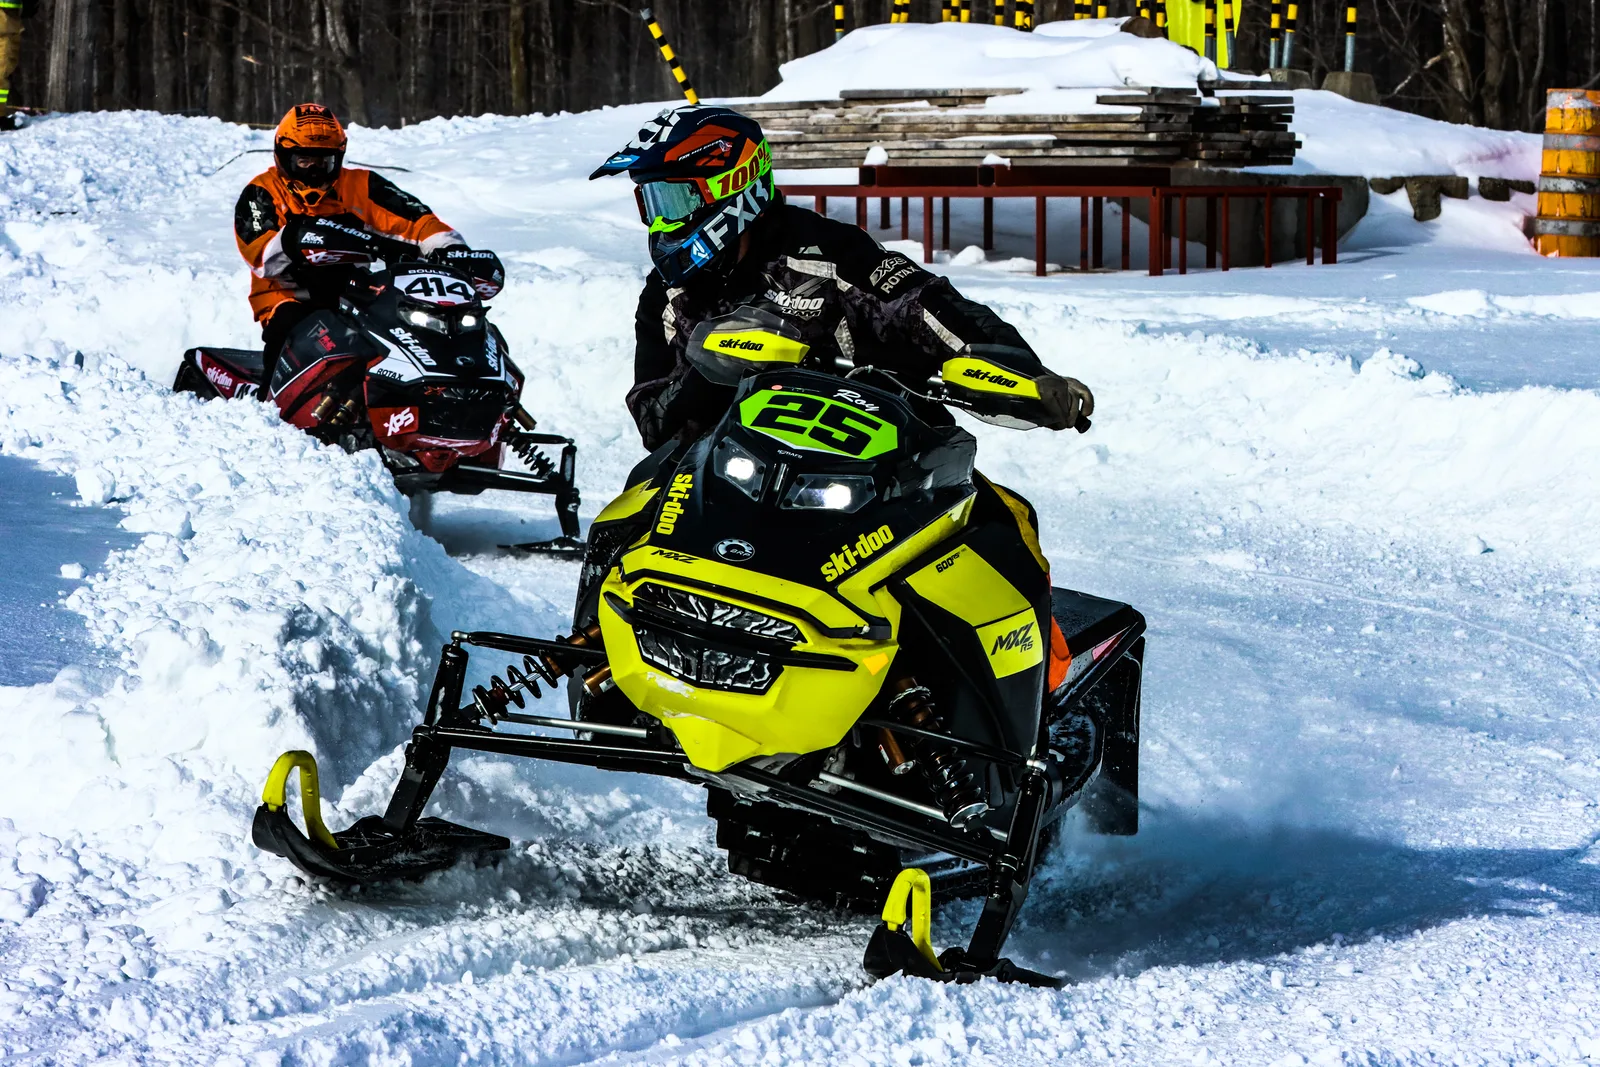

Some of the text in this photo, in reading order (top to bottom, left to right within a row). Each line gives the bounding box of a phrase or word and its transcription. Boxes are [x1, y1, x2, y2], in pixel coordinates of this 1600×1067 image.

[717, 141, 771, 198] 100%
[316, 218, 372, 240] ski-doo
[702, 178, 769, 251] FXR
[446, 250, 494, 260] ski-doo
[408, 268, 452, 277] BOULET
[870, 256, 908, 287] XPS
[880, 264, 921, 295] ROTAX
[404, 277, 475, 301] 414
[389, 327, 437, 366] ski-doo
[718, 338, 765, 351] ski-doo
[377, 368, 405, 380] ROTAX
[962, 368, 1019, 389] ski-doo
[382, 407, 415, 437] XPS
[750, 394, 883, 456] 25
[655, 473, 694, 536] ski-doo
[650, 549, 700, 564] MXZ
[820, 524, 894, 583] ski-doo
[990, 621, 1035, 656] MXZ
[1019, 640, 1033, 653] RS
